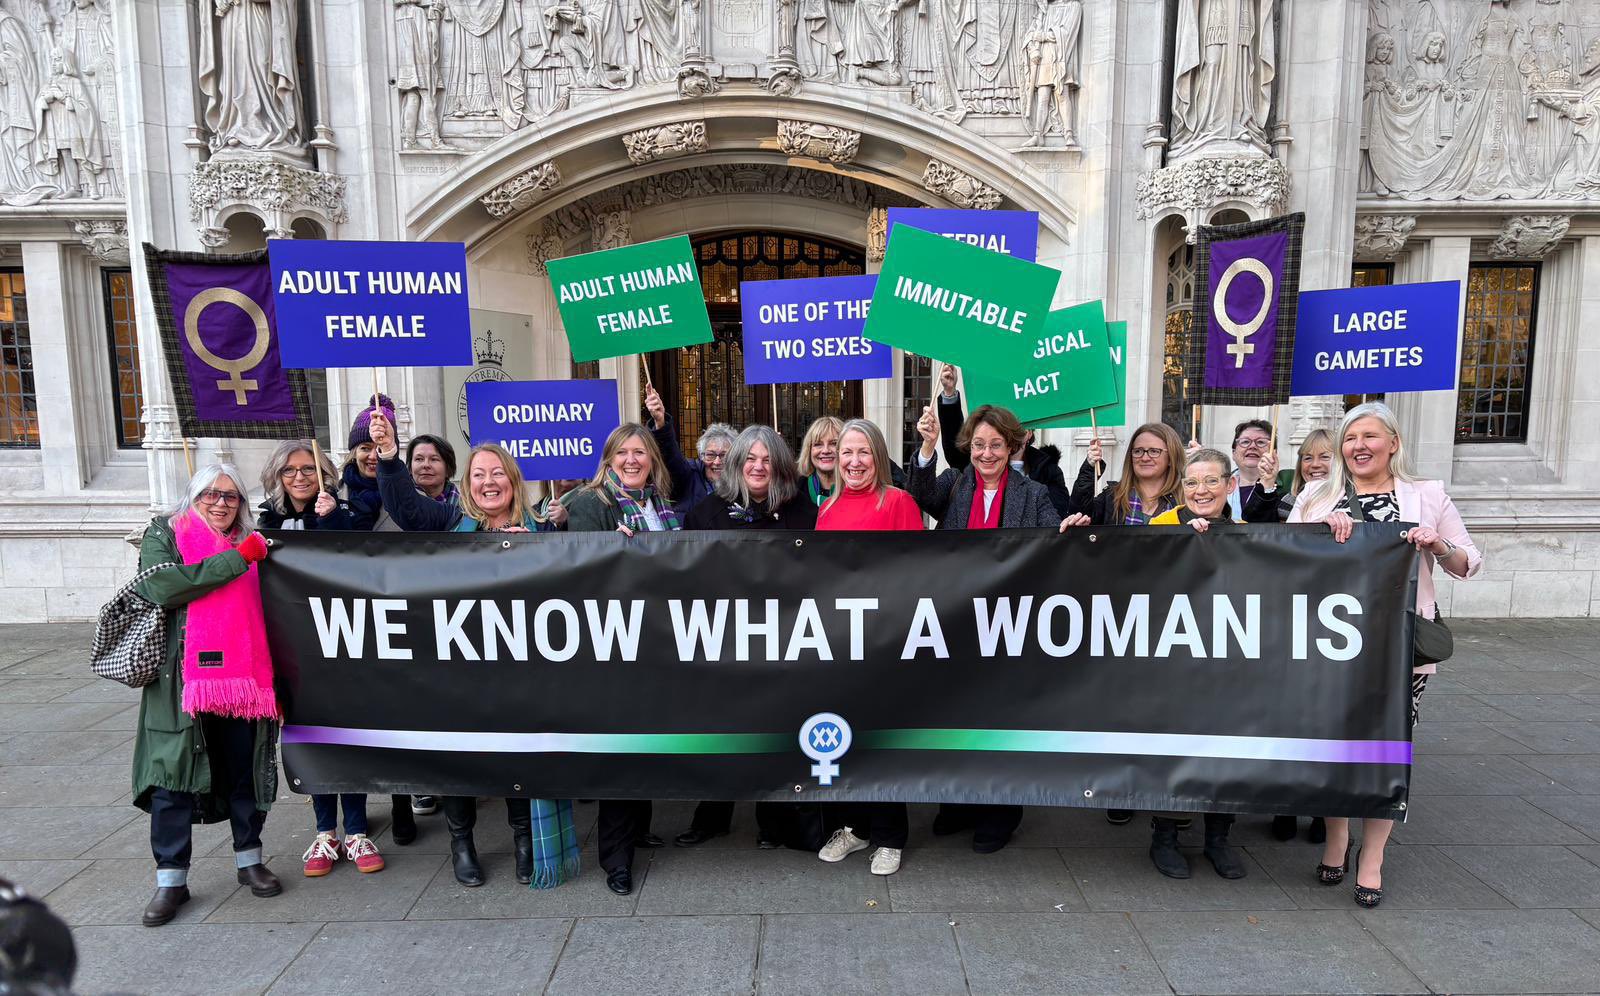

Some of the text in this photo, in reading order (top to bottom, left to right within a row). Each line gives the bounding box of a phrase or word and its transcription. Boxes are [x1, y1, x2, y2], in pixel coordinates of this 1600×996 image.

[279, 270, 462, 295] ADULT HUMAN
[560, 262, 694, 304] ADULT HUMAN
[759, 299, 872, 324] ONE OF THE
[894, 275, 1027, 334] IMMUTABLE
[325, 315, 426, 338] FEMALE
[597, 304, 673, 334] FEMALE
[1333, 309, 1408, 334] LARGE
[762, 336, 873, 360] TWO SEXES
[1033, 329, 1092, 359] GICAL
[1314, 346, 1424, 371] GAMETES
[493, 403, 594, 424] ORDINARY
[500, 437, 593, 458] MEANING
[308, 593, 1364, 662] WE KNOW WHAT A WOMAN IS
[812, 727, 839, 748] XX
